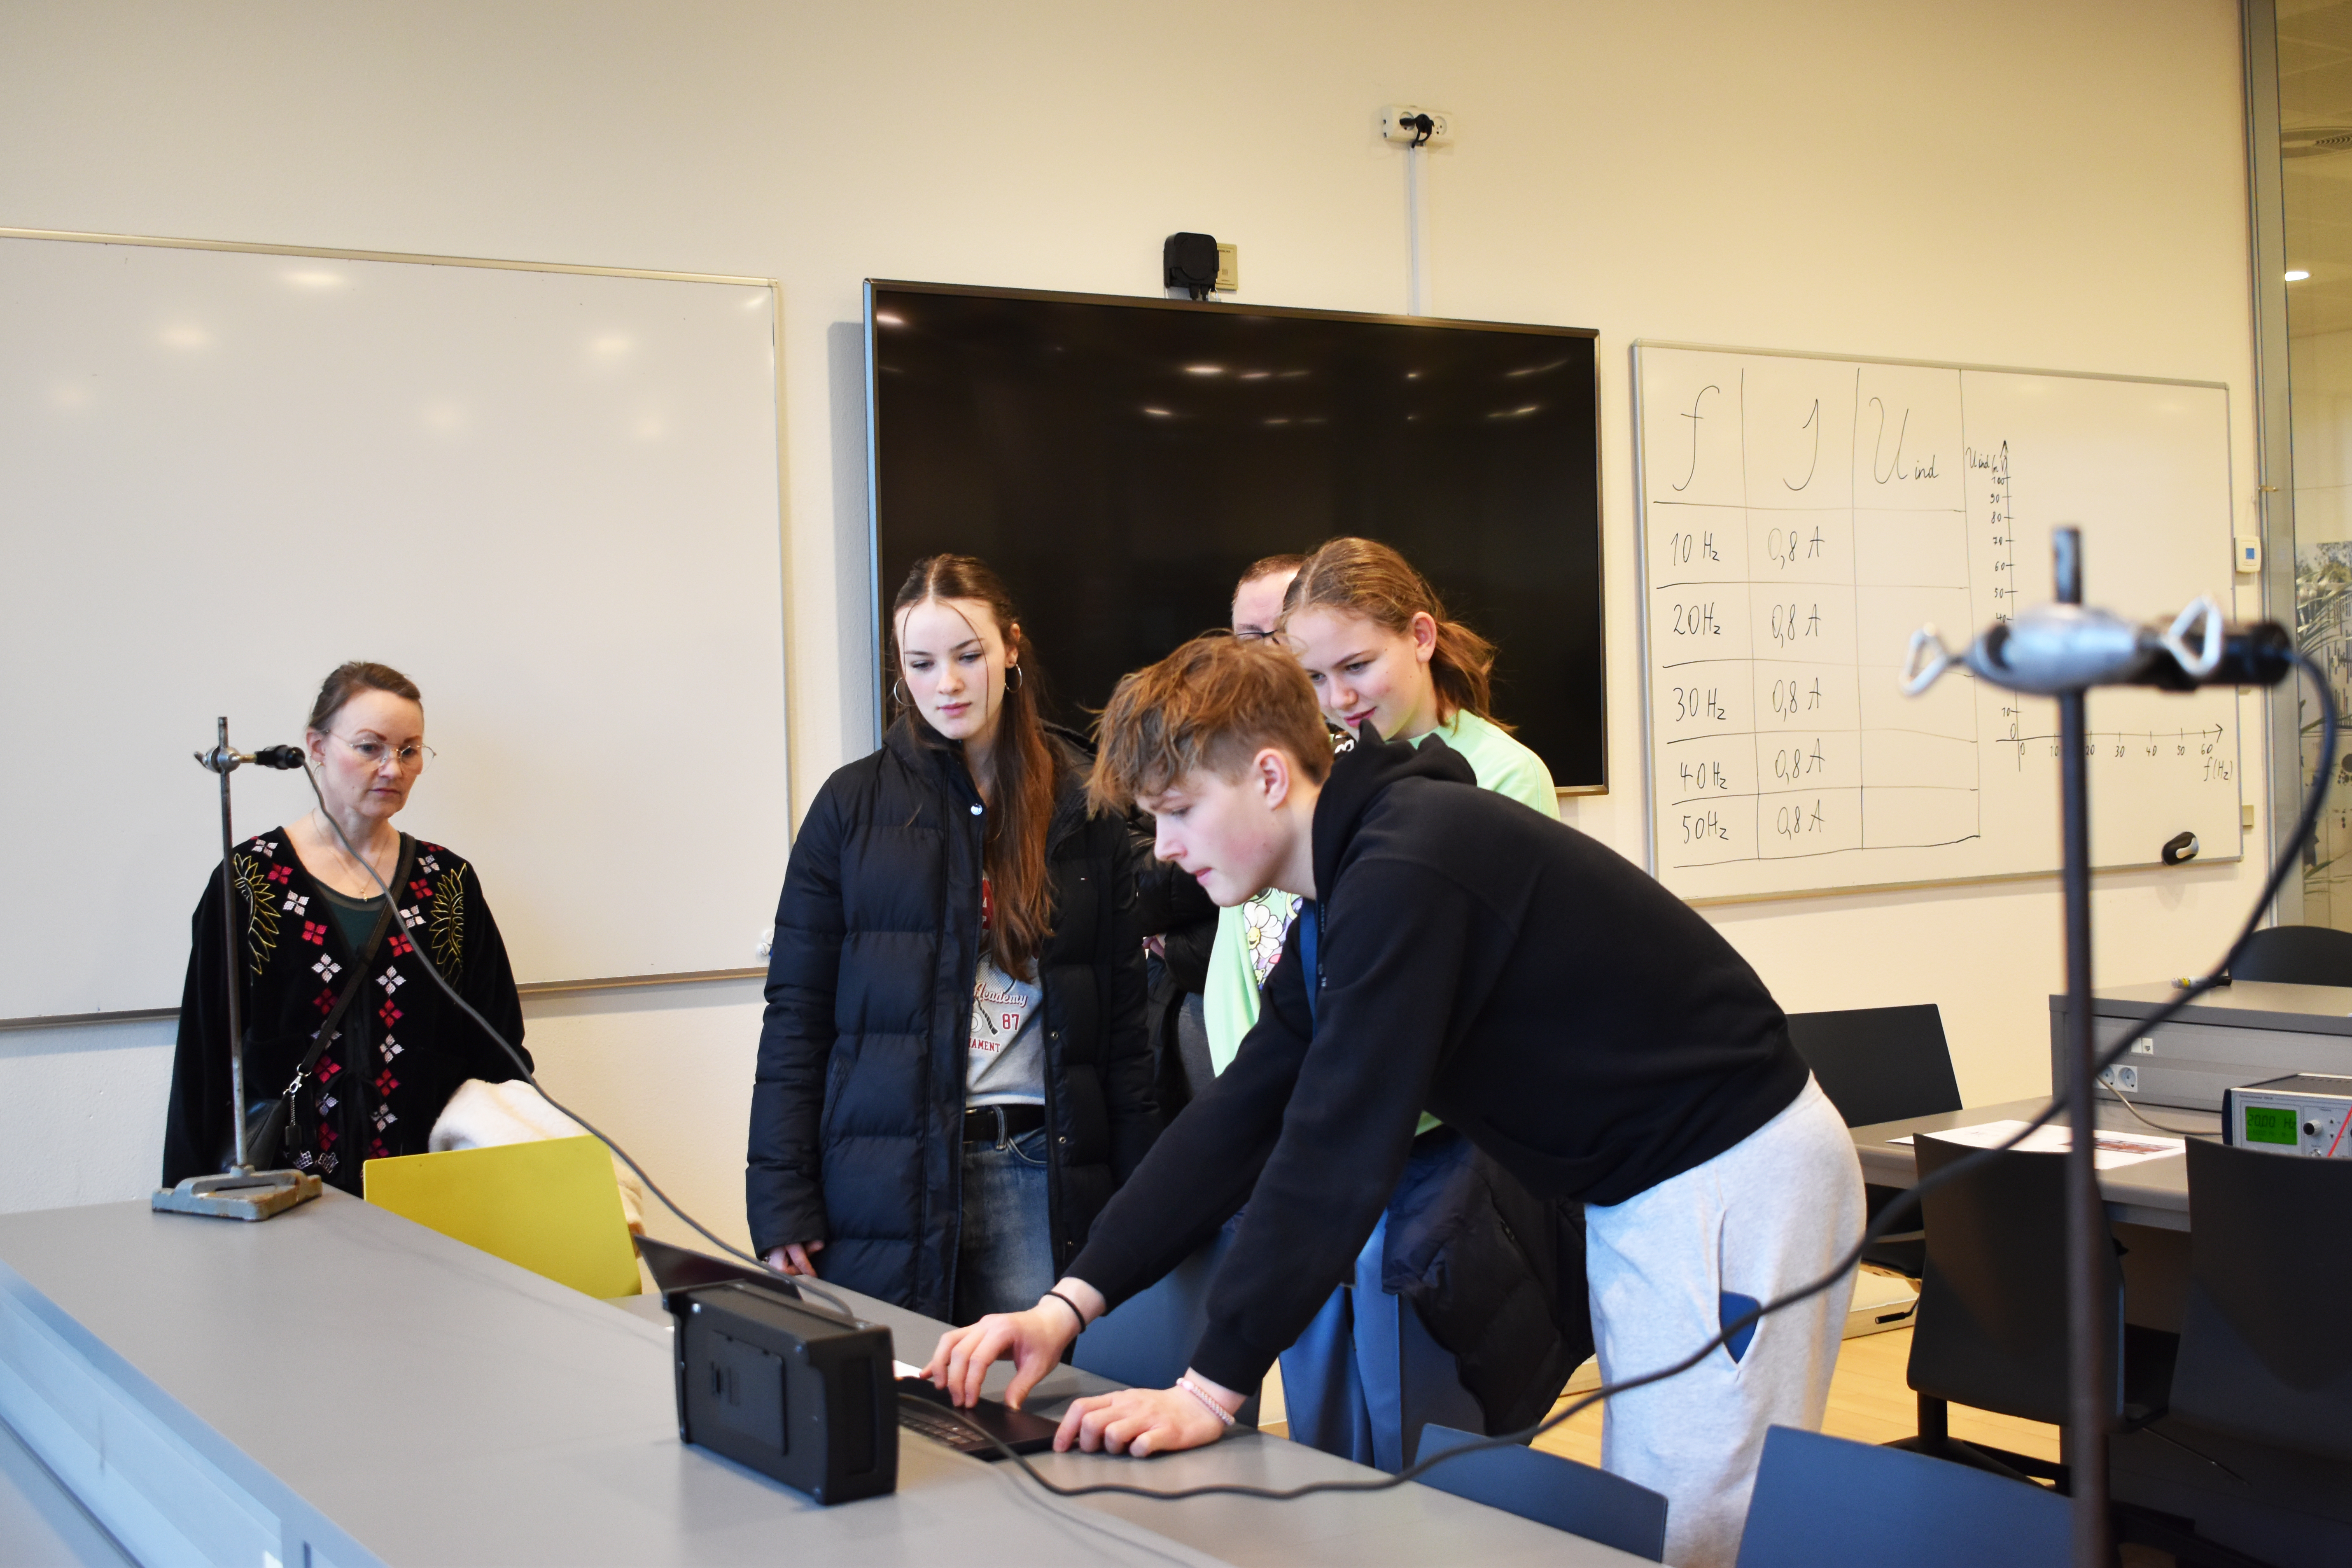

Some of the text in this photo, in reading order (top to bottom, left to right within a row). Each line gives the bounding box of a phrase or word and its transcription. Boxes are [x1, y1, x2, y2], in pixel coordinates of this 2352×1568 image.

[1672, 385, 1720, 491] f
[1990, 493, 2000, 504] 90
[1991, 511, 2001, 524] 80
[1768, 528, 1798, 570] 0,8
[1808, 525, 1825, 559] A
[1995, 561, 2005, 571] 60
[1995, 588, 2003, 598] 50
[1771, 603, 1796, 649] 0,8
[1805, 603, 1821, 637] A
[1996, 613, 2006, 623] 40
[1772, 679, 1798, 722] 0,8
[1808, 677, 1822, 710] A
[2002, 707, 2010, 716] 10
[2010, 723, 2016, 739] 0
[2020, 742, 2025, 755] 0
[2115, 746, 2125, 757] 30
[2146, 745, 2157, 757] 40
[2177, 746, 2185, 756] 50
[2201, 744, 2213, 755] 60
[1775, 748, 1801, 785] 0,8
[1806, 738, 1825, 774] A
[1777, 805, 1800, 840] 0,8
[1808, 799, 1826, 833] A
[974, 981, 1028, 1008] Academy
[1002, 1013, 1020, 1031] 87
[2284, 1118, 2296, 1129] Hz
